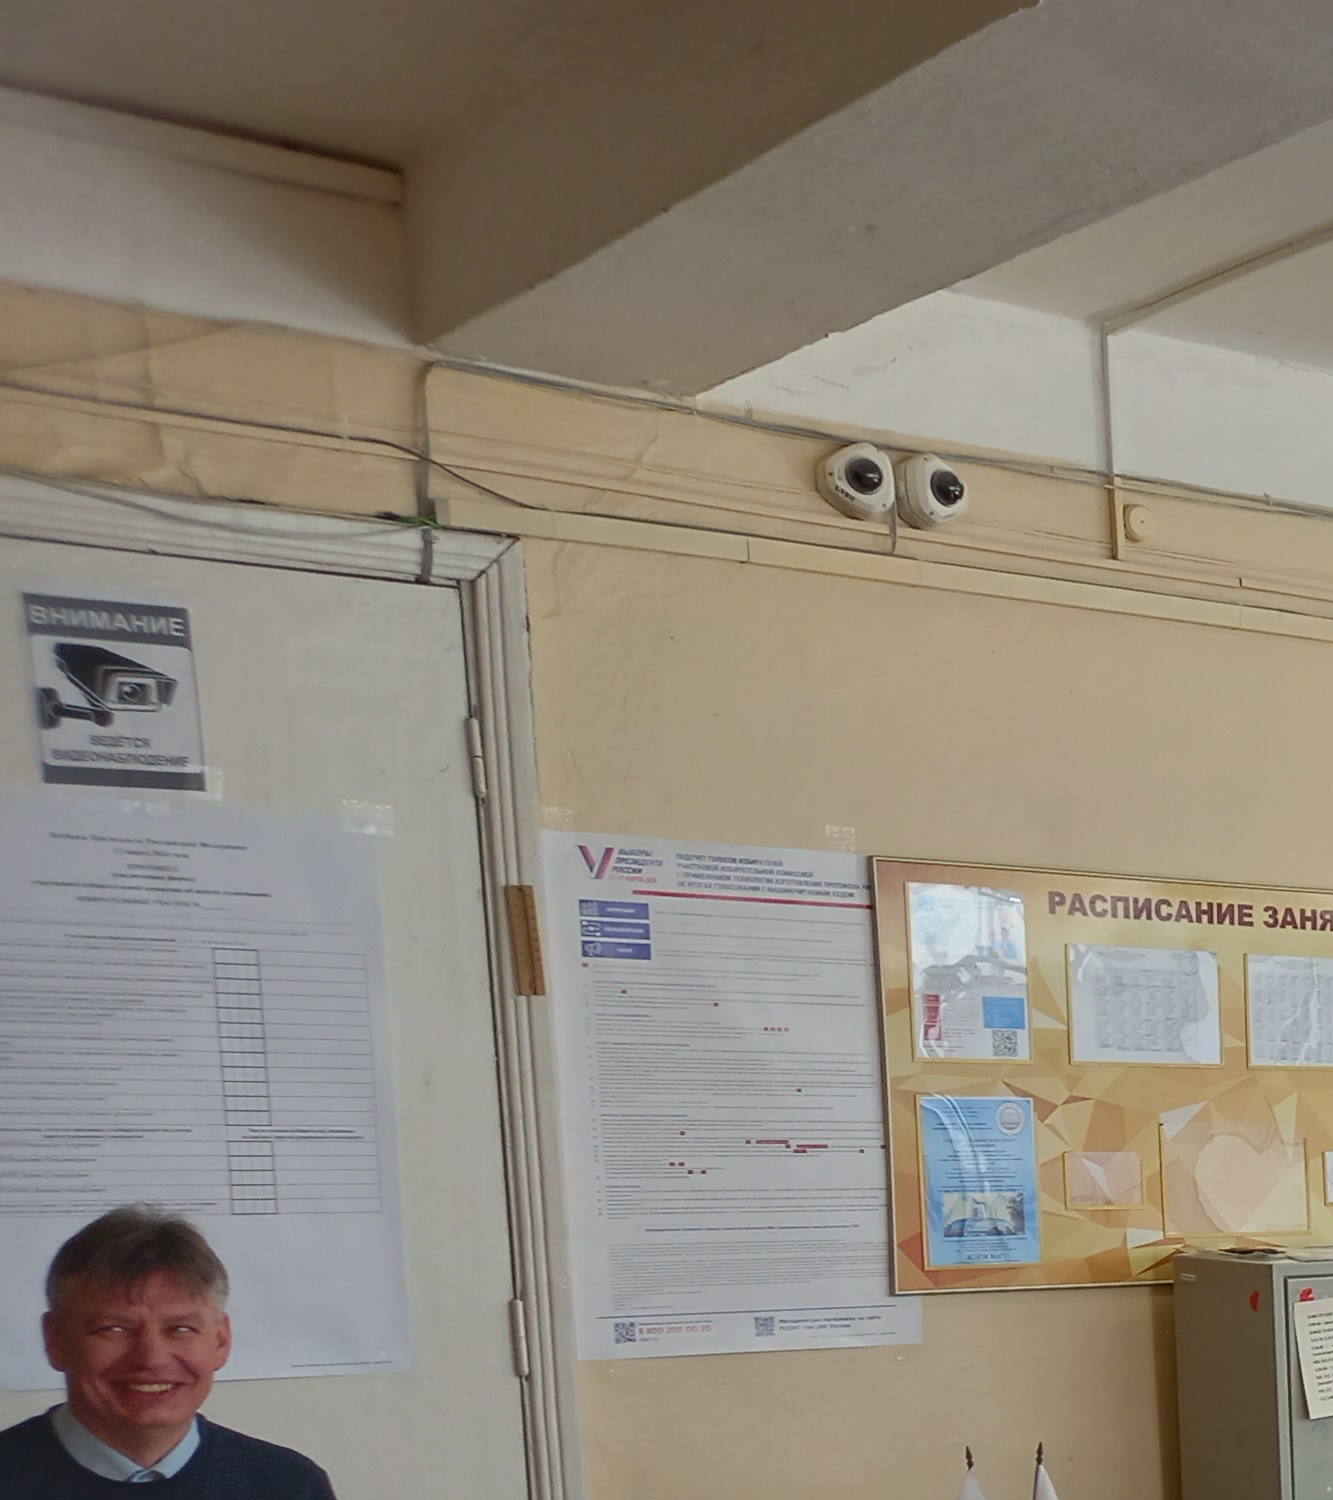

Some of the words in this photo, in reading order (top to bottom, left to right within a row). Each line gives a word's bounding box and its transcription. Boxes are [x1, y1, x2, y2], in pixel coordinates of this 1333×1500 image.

[30, 604, 187, 638] ВНИМАНИЕ
[52, 748, 189, 767] ВИДЕОНАБЛЮДЕНИЕ
[618, 848, 653, 857] ВЫБОРЫ
[615, 857, 663, 867] ПРЕЗИДЕНТА
[612, 866, 643, 874] РОССИИ
[1047, 890, 1254, 927] РАСПИСАНИЕ
